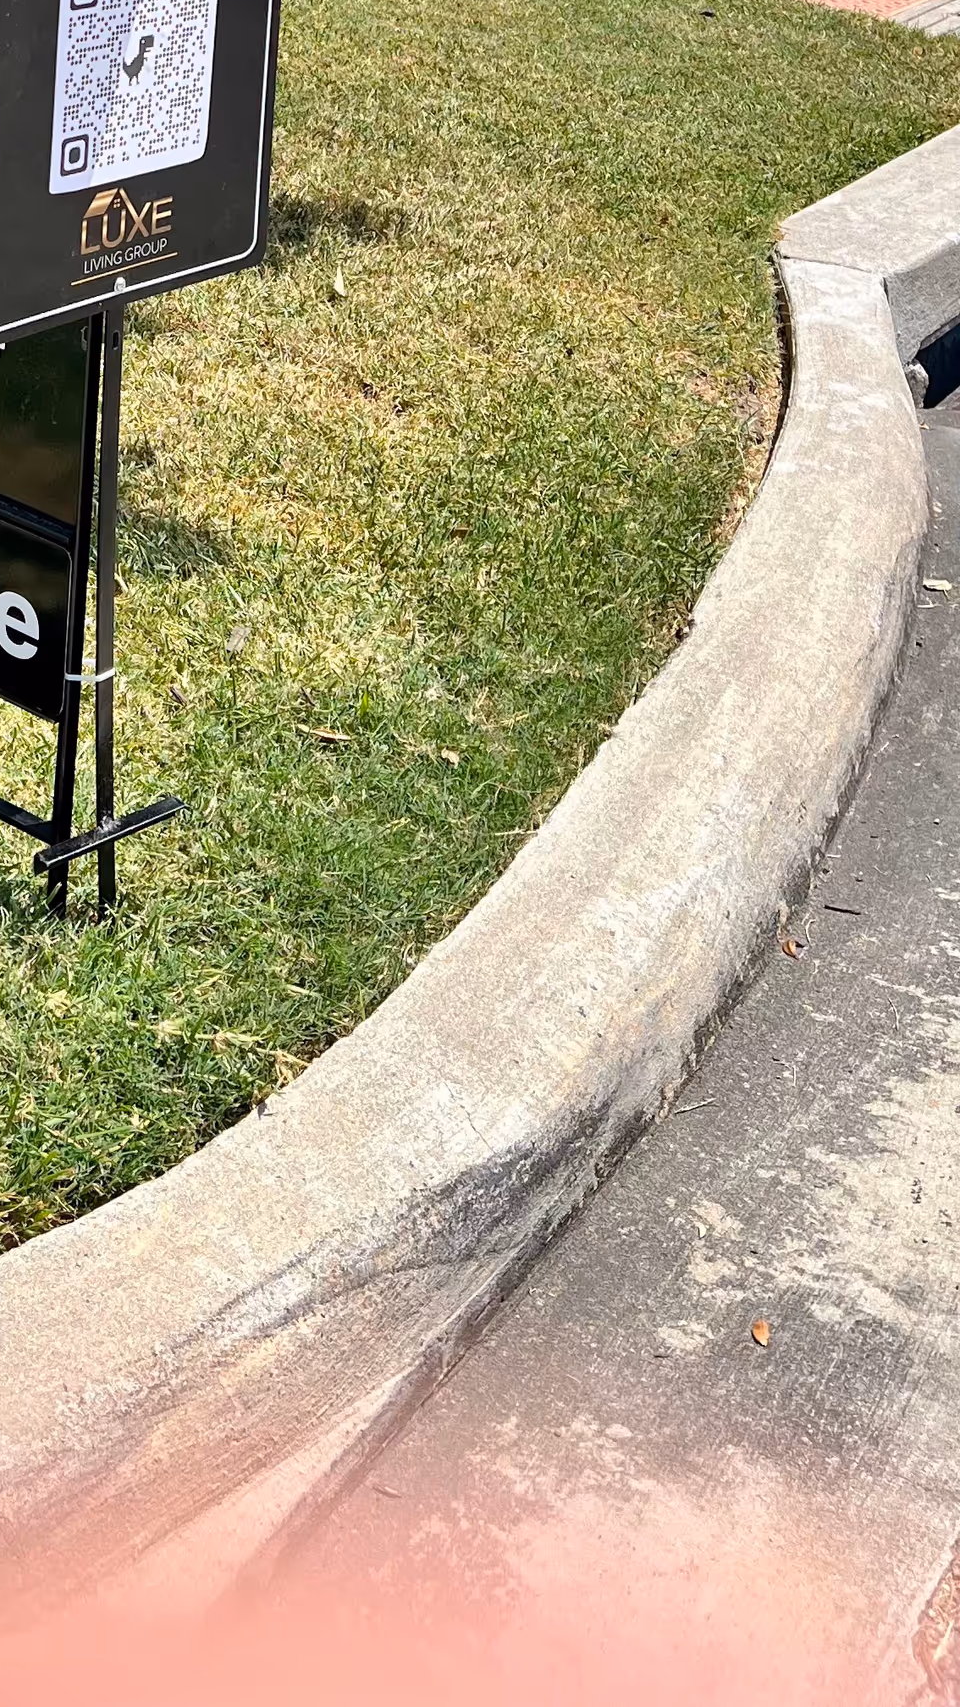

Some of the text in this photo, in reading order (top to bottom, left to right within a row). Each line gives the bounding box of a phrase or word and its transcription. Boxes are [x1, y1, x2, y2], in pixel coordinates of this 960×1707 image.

[81, 188, 173, 255] LUXE
[84, 238, 168, 274] LIVING GROUP
